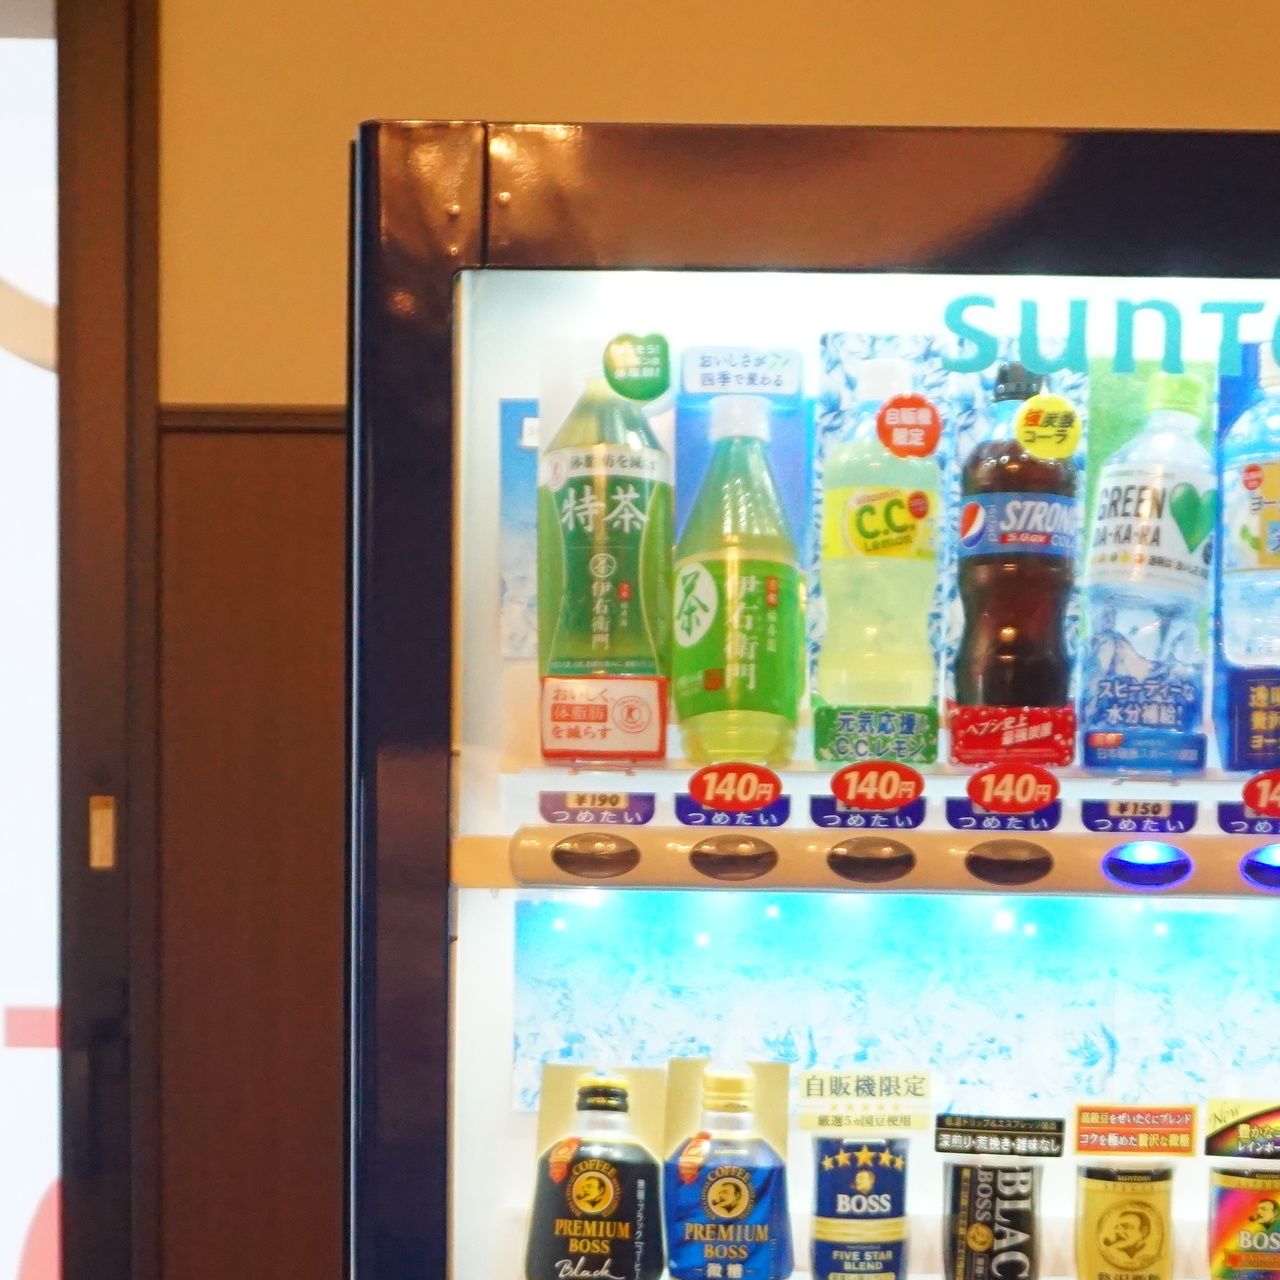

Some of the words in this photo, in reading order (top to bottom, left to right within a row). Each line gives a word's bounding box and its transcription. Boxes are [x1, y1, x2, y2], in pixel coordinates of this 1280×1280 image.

[1023, 430, 1069, 444] コーラ
[561, 484, 649, 533] 特茶
[1098, 484, 1168, 520] GREEN
[855, 498, 916, 539] C.C.
[999, 500, 1078, 533] STRON
[676, 571, 709, 637] 茶
[835, 736, 926, 759] C.C.レモン
[702, 772, 774, 801] 140円
[843, 770, 916, 801] 140円
[980, 773, 1051, 803] 140円
[553, 810, 642, 824] つめたい
[688, 811, 777, 825] つめたい
[1117, 802, 1162, 816] ¥150
[823, 814, 913, 828] つめたい
[958, 816, 1048, 830] つめたい
[1094, 818, 1184, 831] つめたい
[805, 1074, 927, 1098] 自販機限定
[836, 1193, 892, 1214] BOSS
[975, 1168, 994, 1223] BOSS
[554, 1219, 631, 1238] PREMIUM
[684, 1223, 769, 1243] PREMIUM
[568, 1238, 610, 1254] BOSS
[703, 1244, 748, 1260] BOSS
[832, 1250, 860, 1261] FIVE
[864, 1251, 893, 1261] STAR
[554, 1256, 626, 1280] Black
[844, 1261, 883, 1272] BLEND
